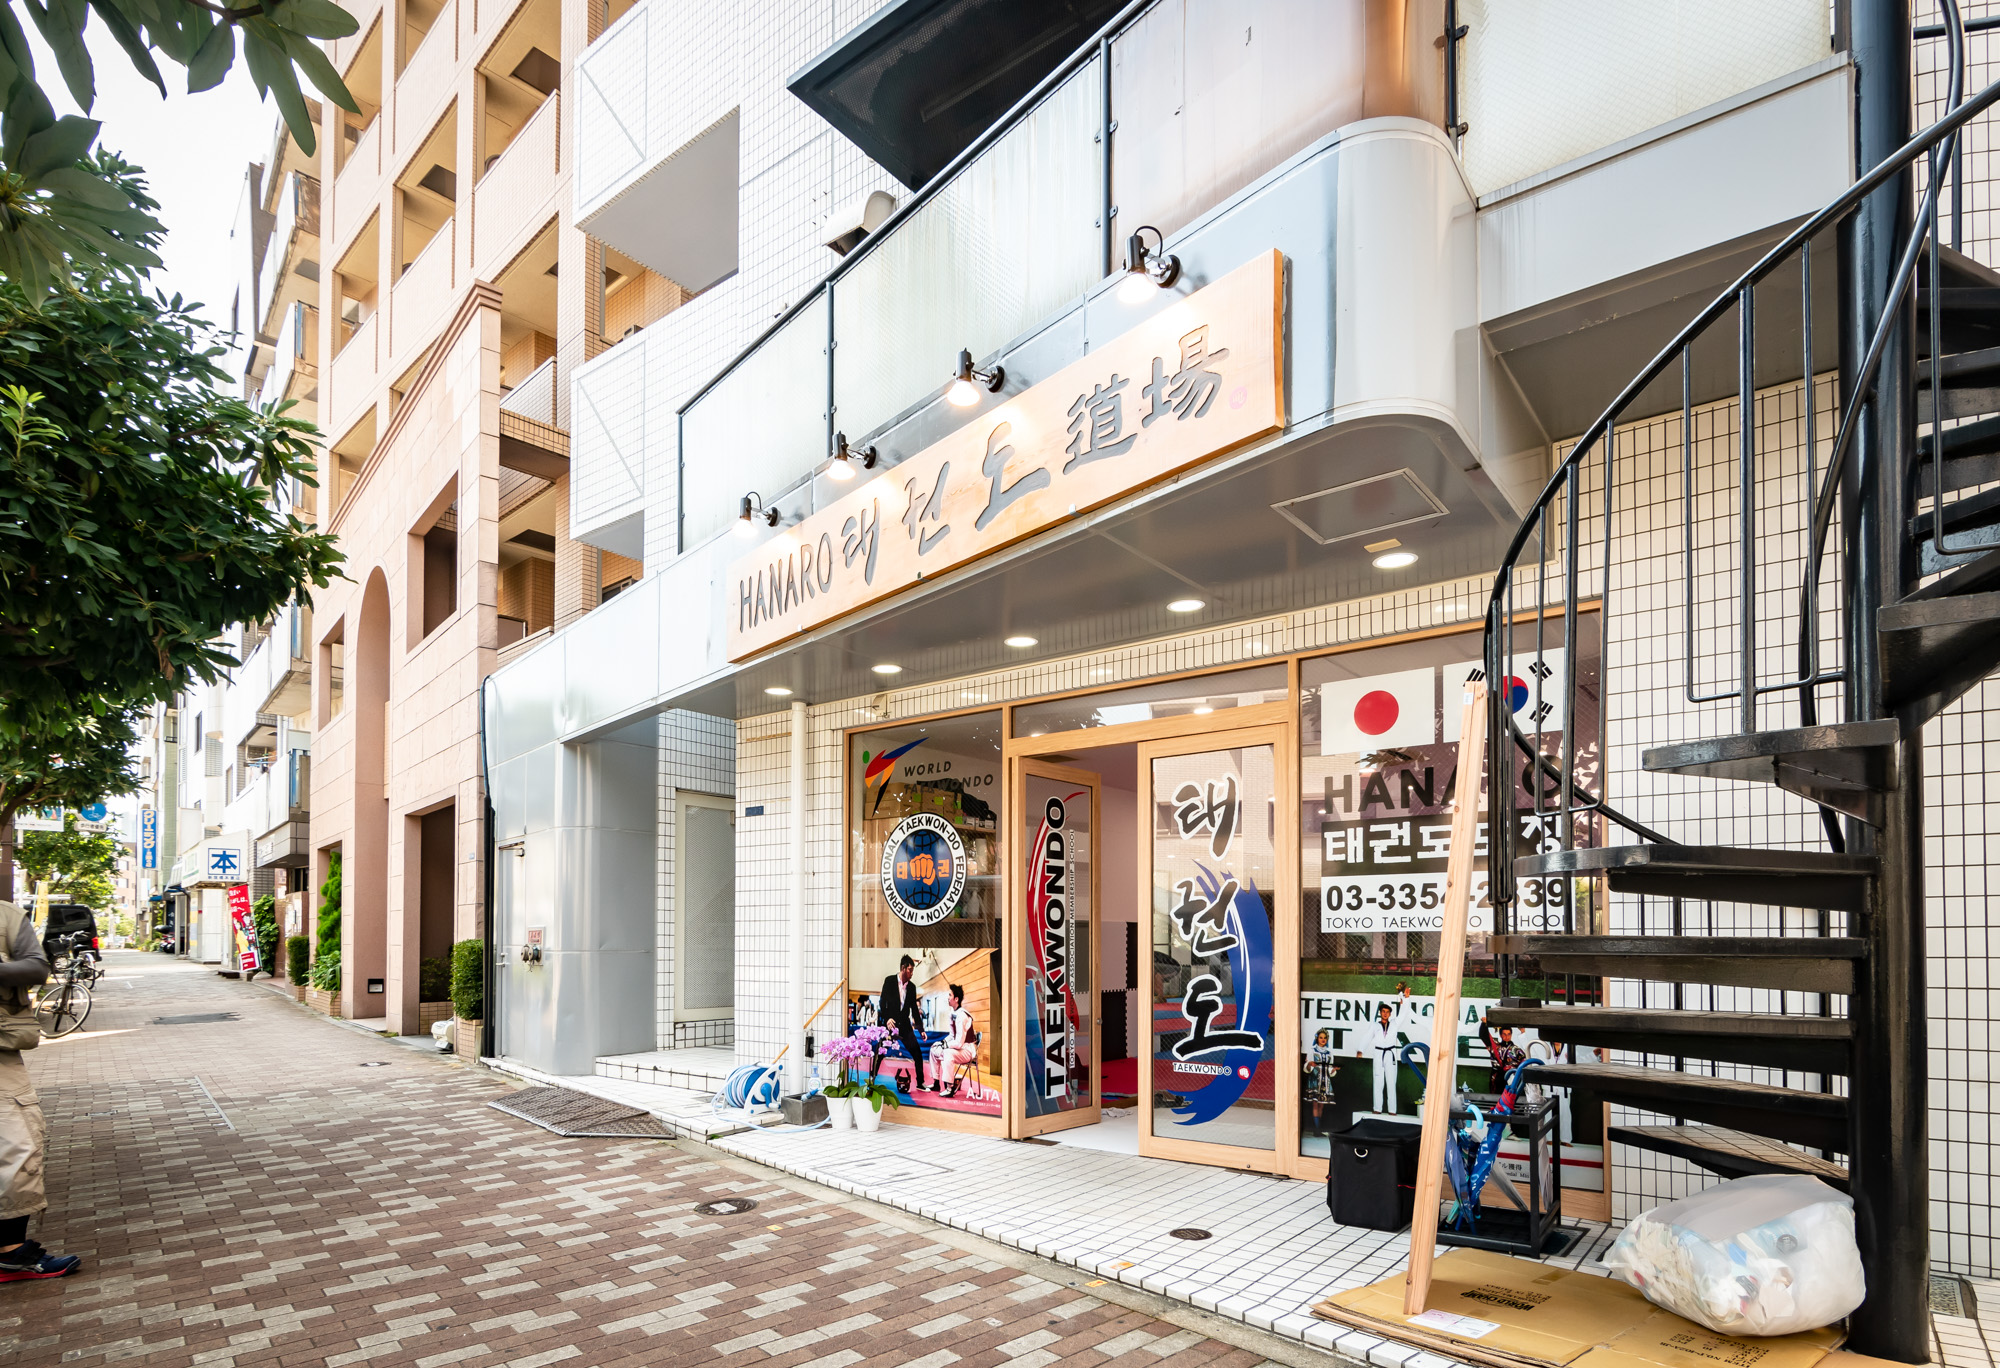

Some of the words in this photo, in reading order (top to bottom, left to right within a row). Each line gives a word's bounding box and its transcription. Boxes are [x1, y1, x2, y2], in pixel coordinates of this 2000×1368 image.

[738, 531, 834, 634] HANARO
[1063, 323, 1230, 476] 道場
[904, 761, 952, 777] WORLD
[904, 774, 994, 794] TAEKWONDO
[143, 811, 156, 849] クリーニング
[898, 815, 960, 851] TAEKWON-DO
[211, 850, 238, 874] 本
[883, 839, 918, 923] INTERNATIONAL
[926, 855, 965, 923] FEDERATION
[1325, 917, 1373, 929] TOKYO
[1046, 797, 1065, 1098] TAEKWONDO
[1173, 1063, 1232, 1076] TAEKWONDO
[966, 1087, 1000, 1102] AJTA
[1497, 1298, 1535, 1311] WORLD
